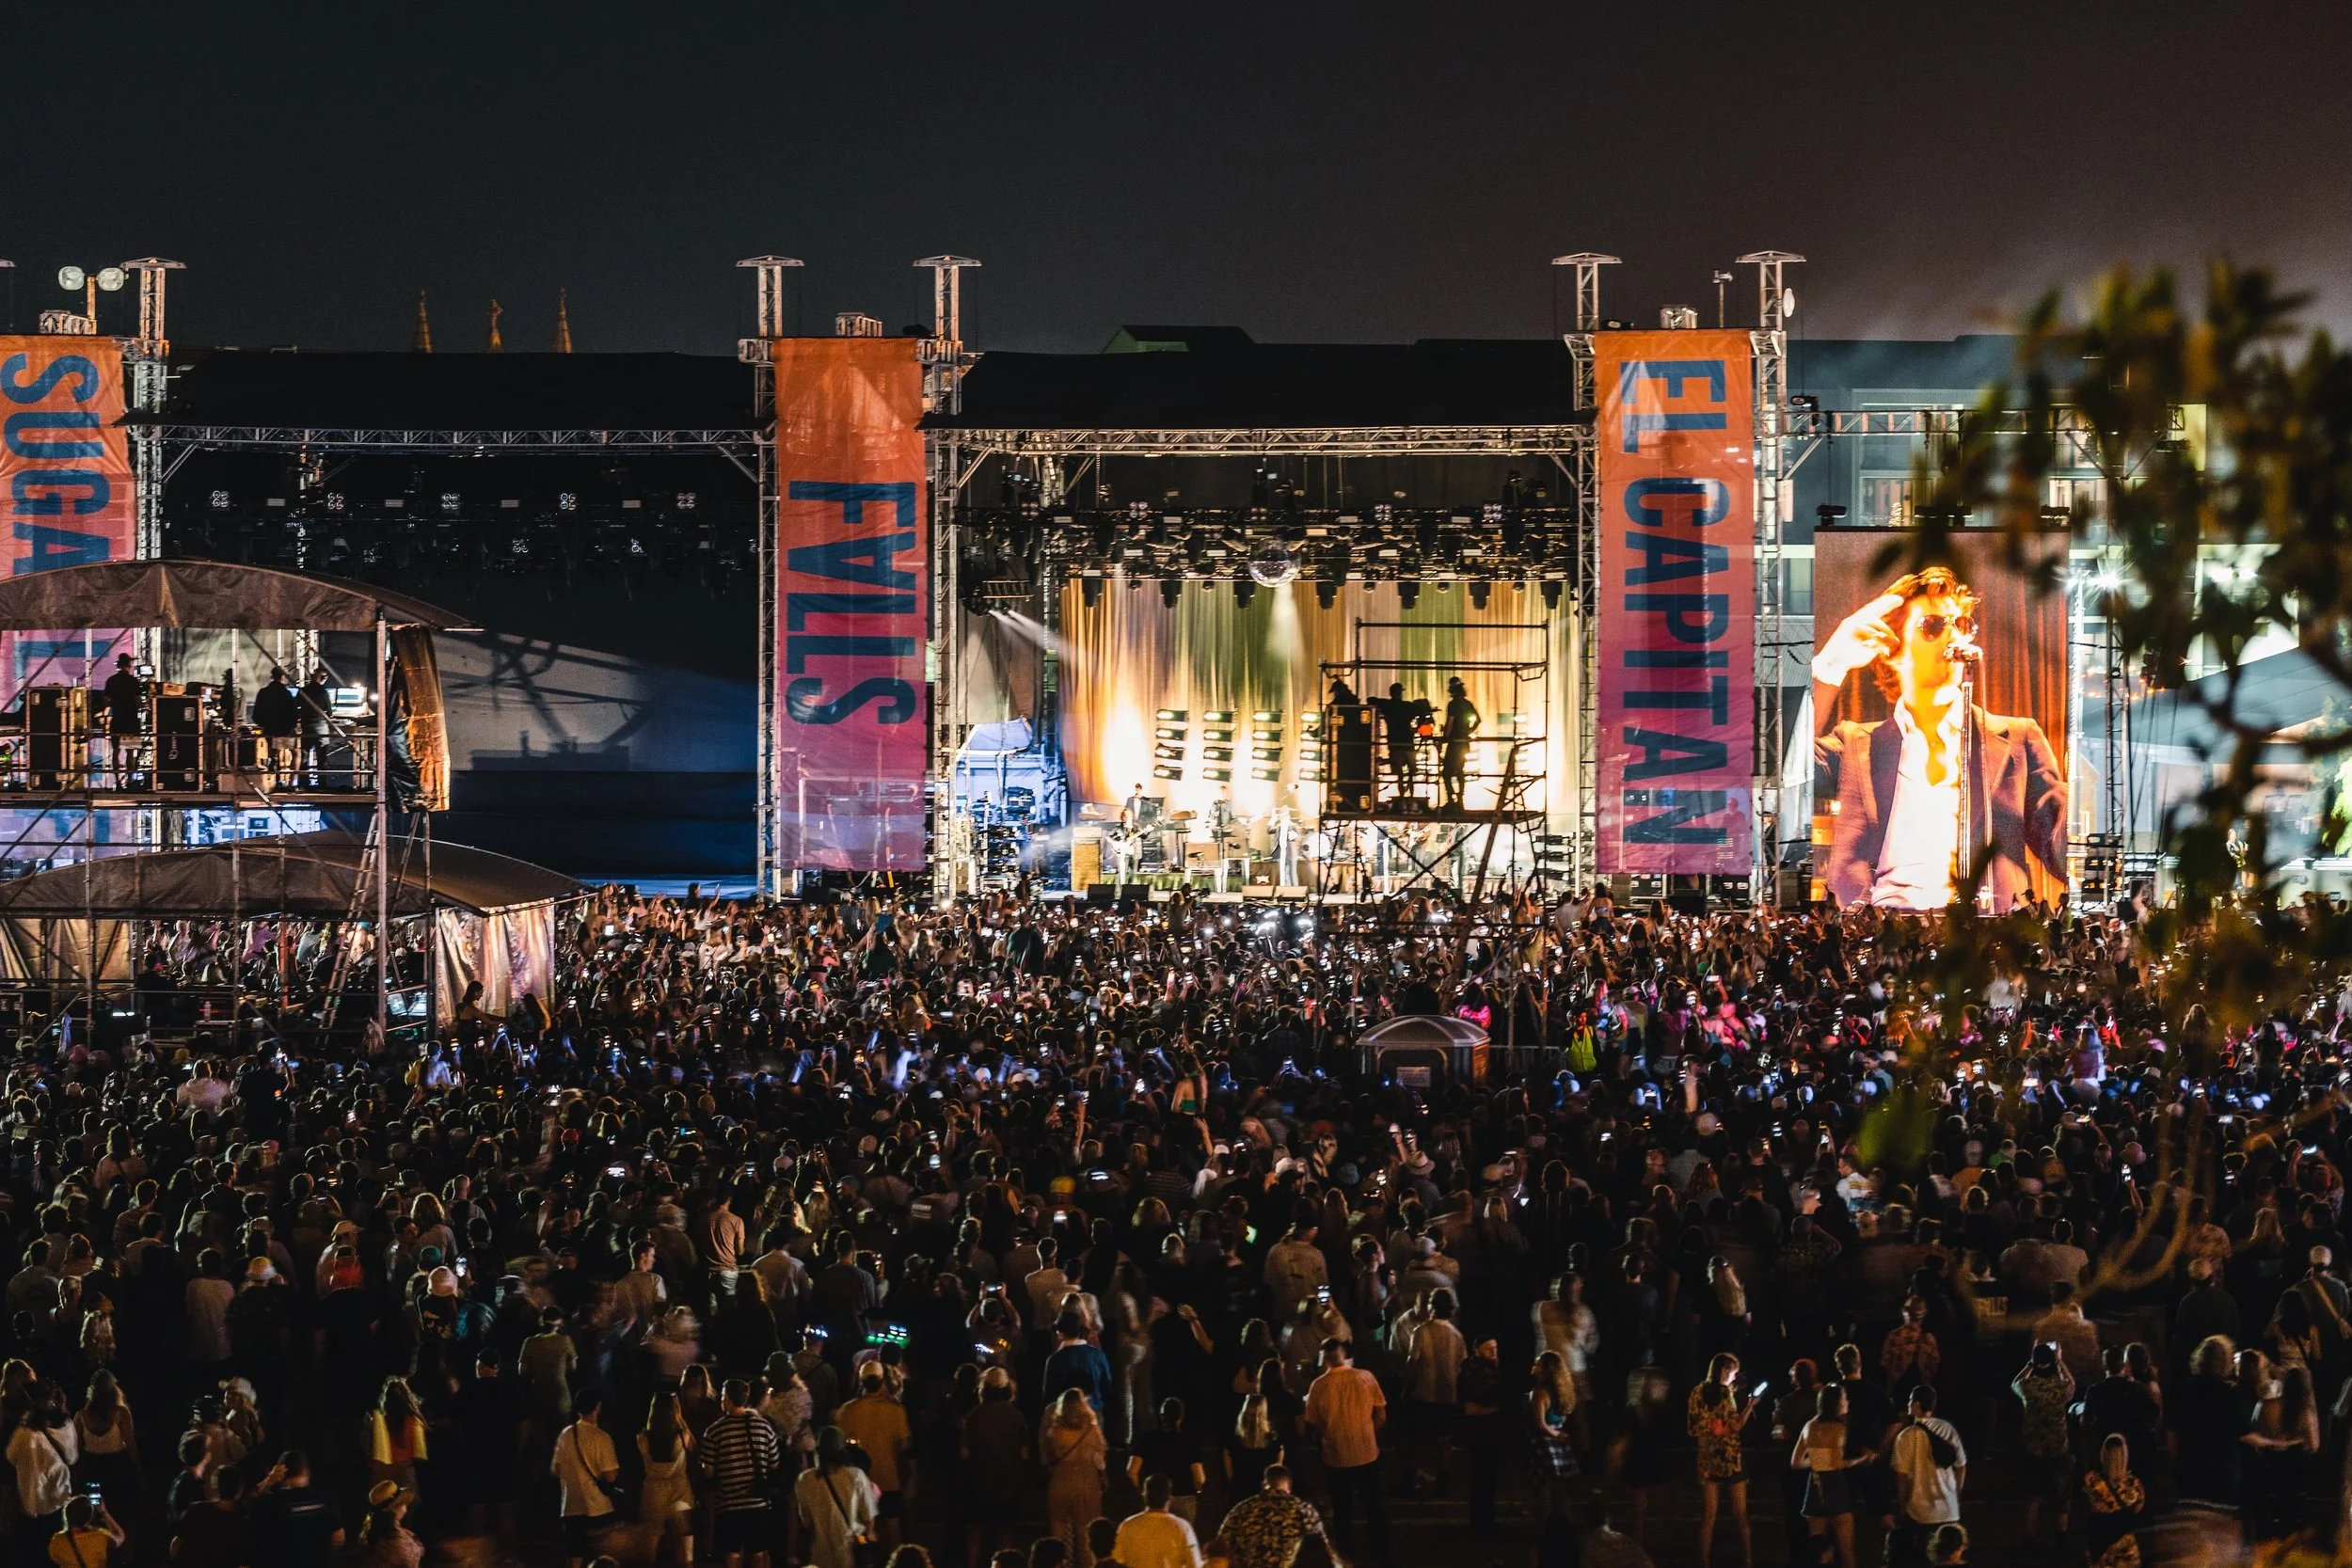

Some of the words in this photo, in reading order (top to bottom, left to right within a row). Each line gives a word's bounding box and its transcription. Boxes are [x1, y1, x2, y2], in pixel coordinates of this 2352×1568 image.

[1619, 360, 1726, 453] EL
[786, 481, 916, 724] FALLS
[1623, 477, 1730, 844] CAPITAN
